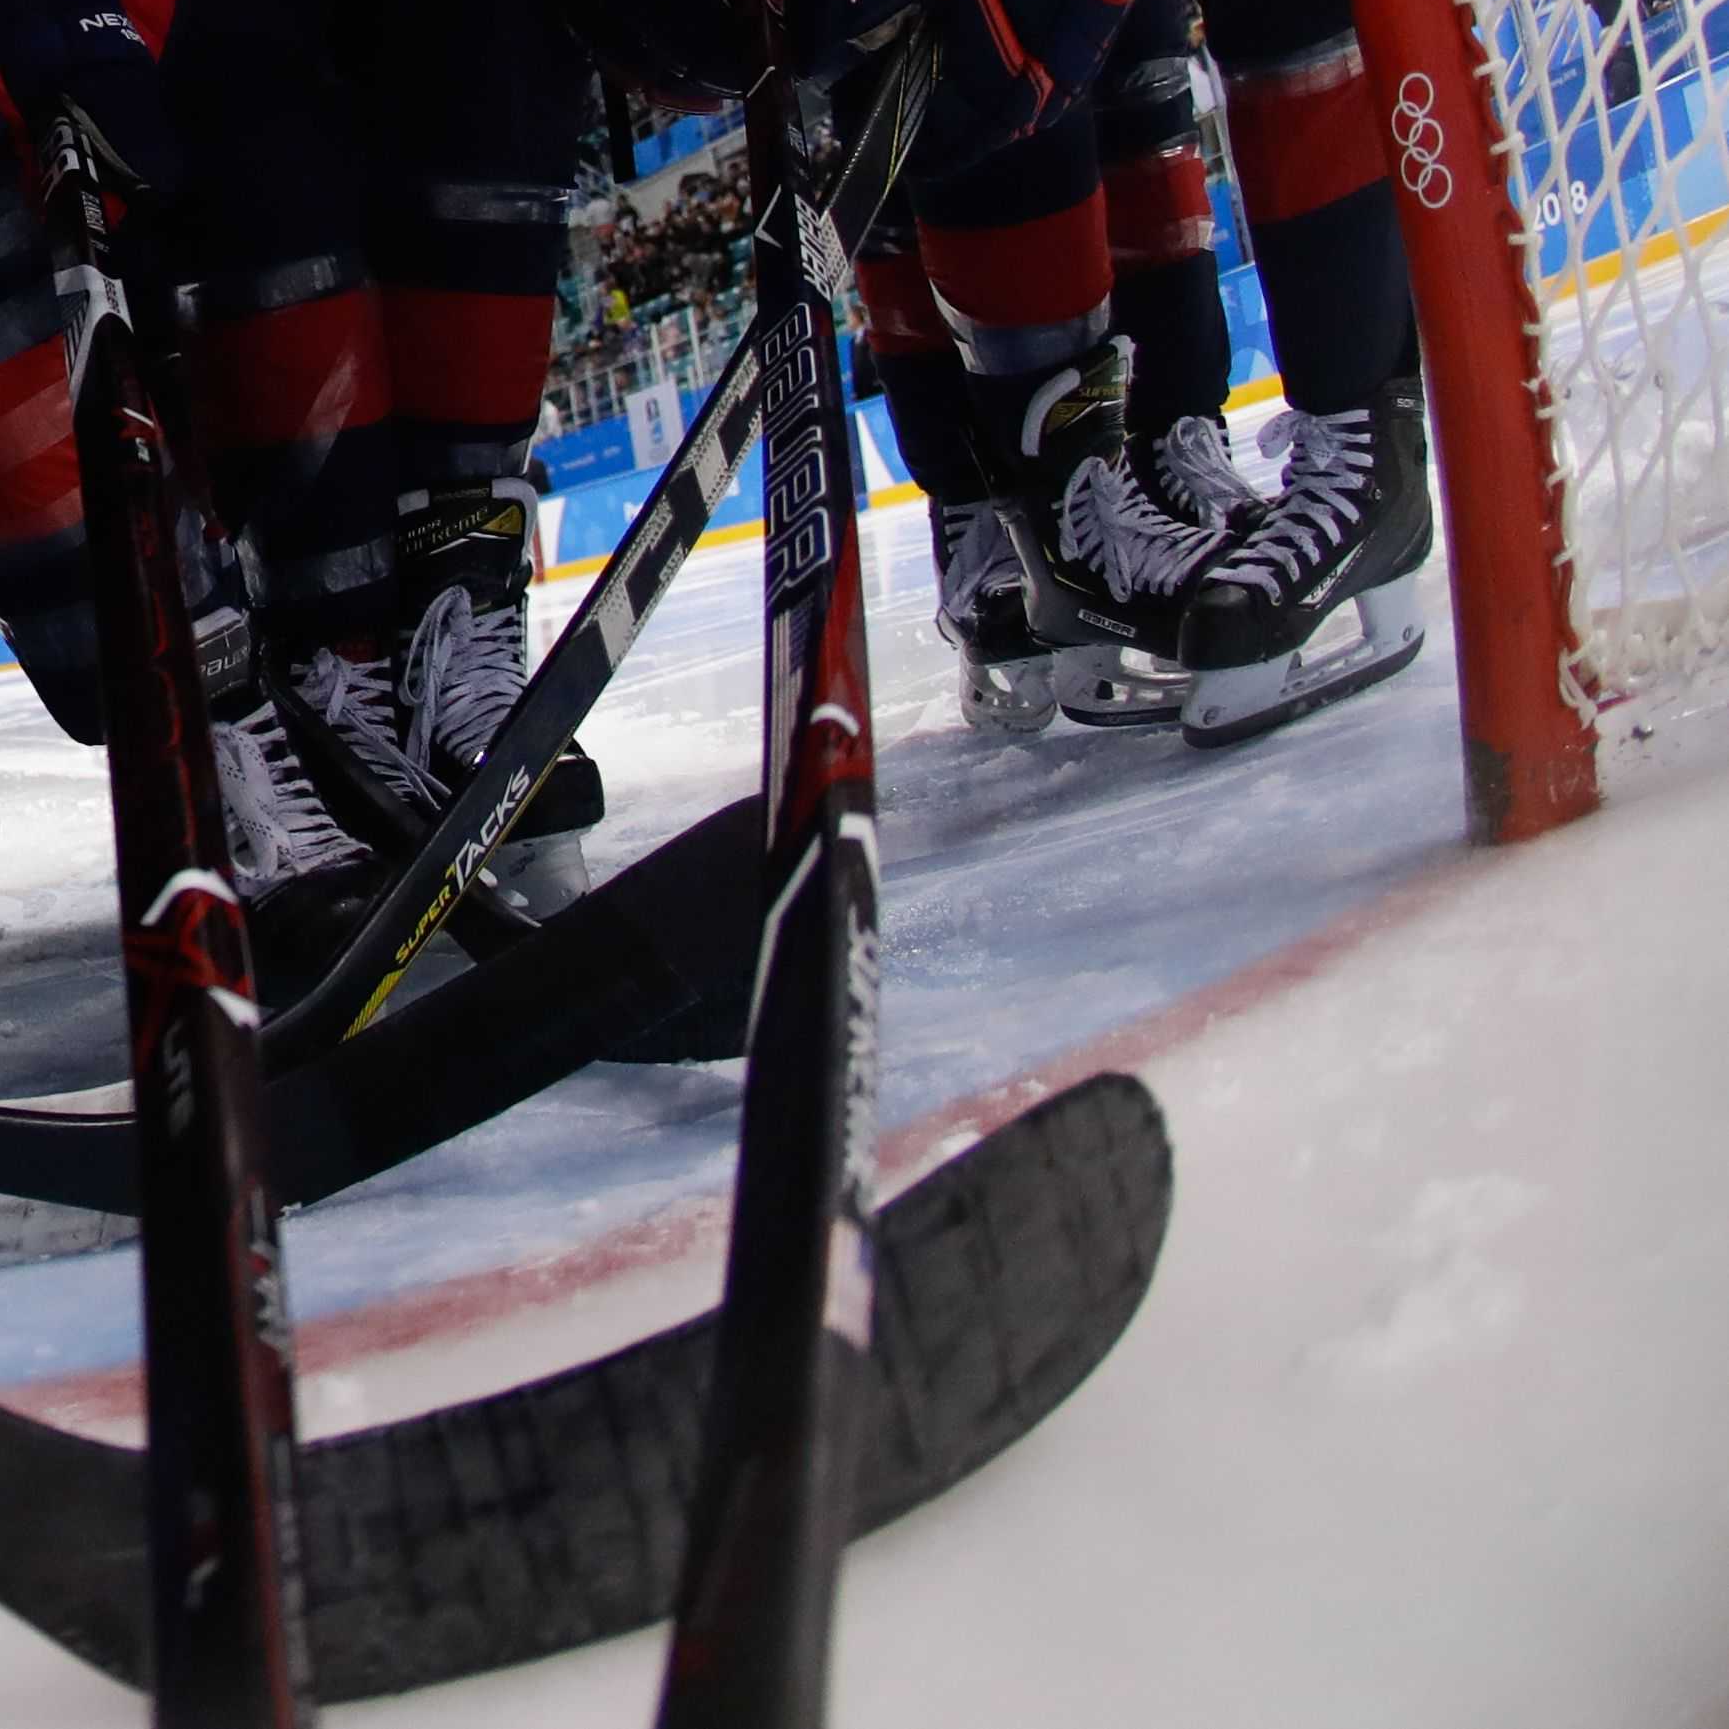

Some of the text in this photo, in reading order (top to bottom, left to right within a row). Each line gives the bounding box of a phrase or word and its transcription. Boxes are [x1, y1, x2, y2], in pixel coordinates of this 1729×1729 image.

[78, 11, 137, 33] NEX
[394, 763, 532, 965] SUPER TACKS
